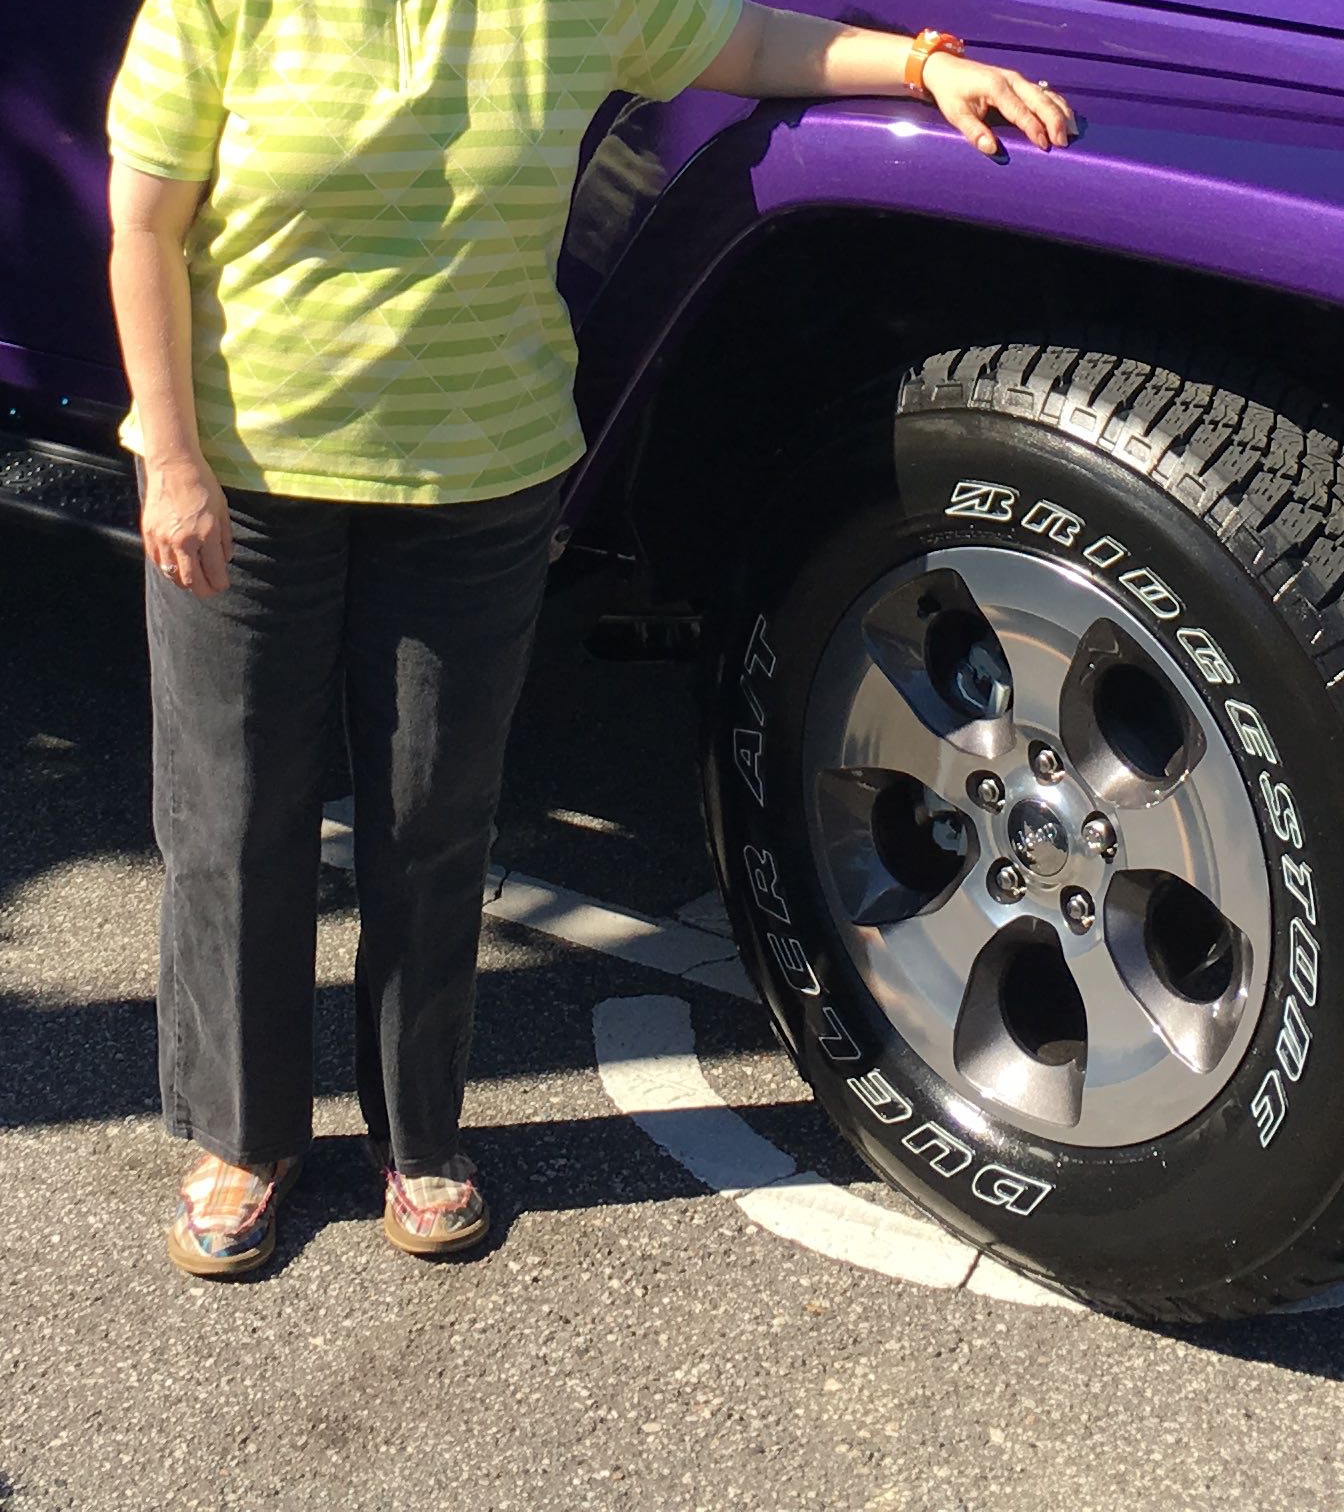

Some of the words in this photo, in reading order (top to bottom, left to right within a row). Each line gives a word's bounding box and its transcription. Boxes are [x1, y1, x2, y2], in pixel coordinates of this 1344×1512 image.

[732, 613, 779, 808] A/T
[944, 479, 1324, 1149] BRIDGESTONE
[742, 843, 1055, 1218] DUELER
